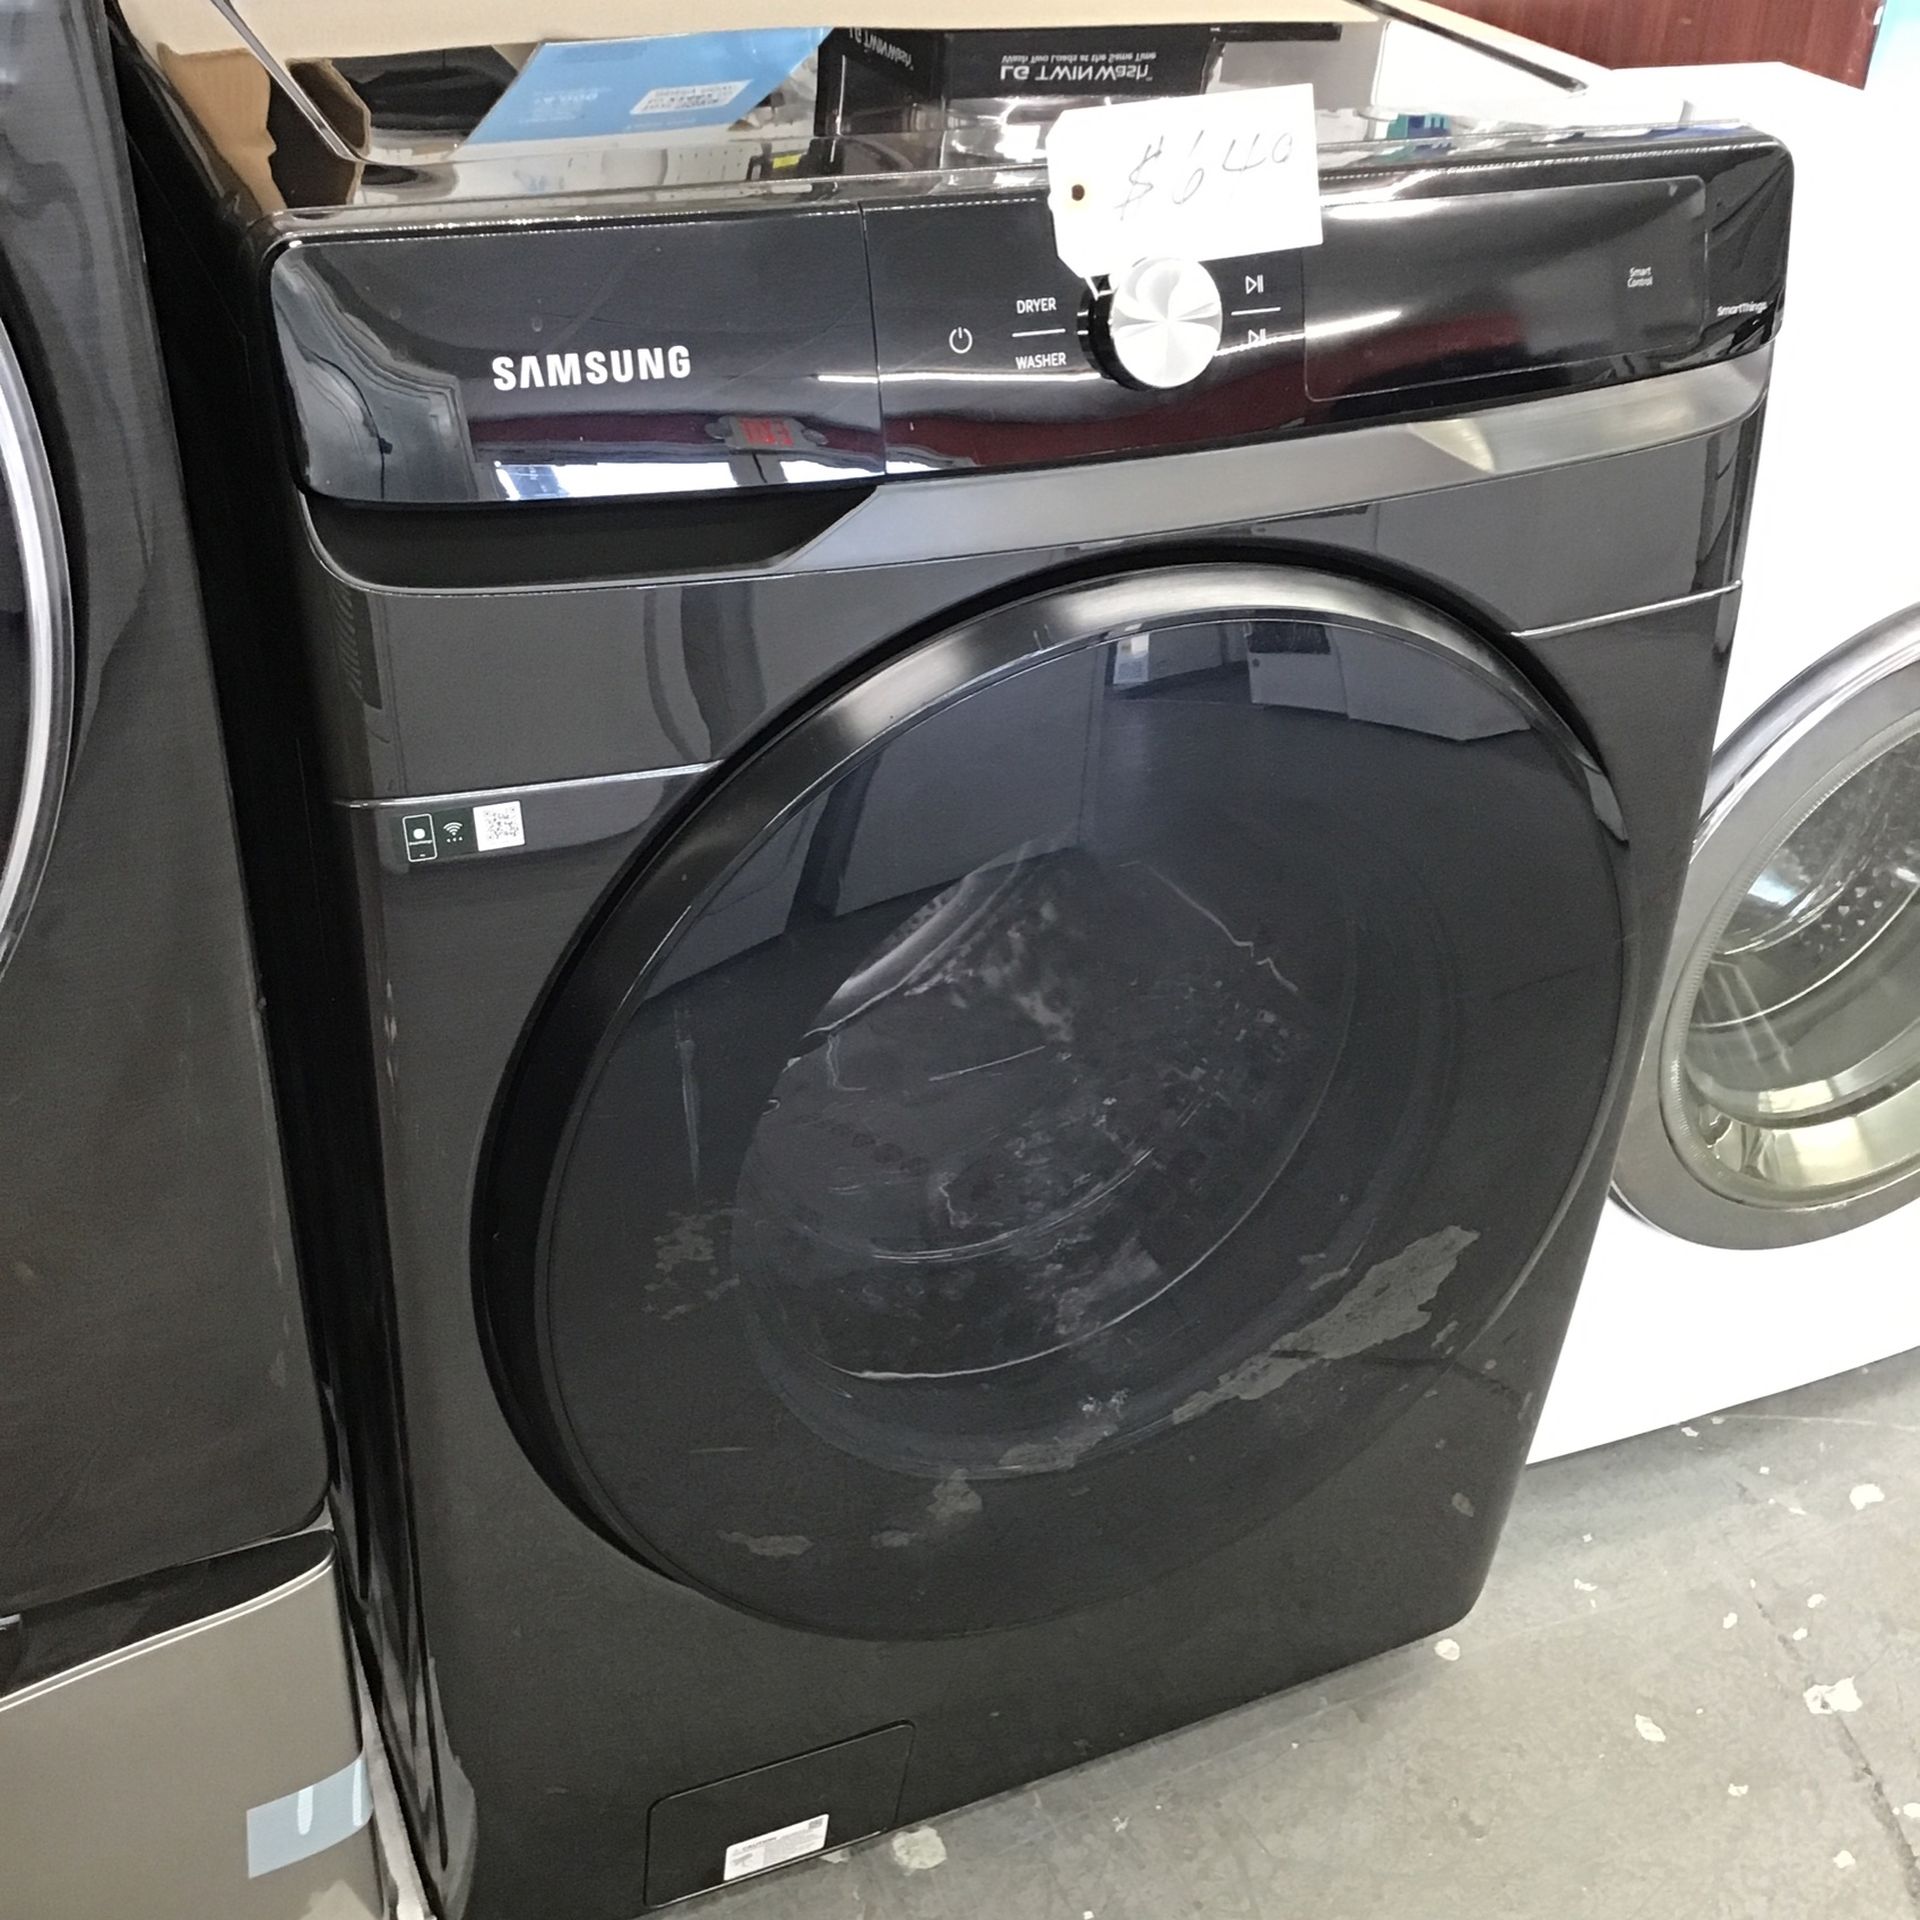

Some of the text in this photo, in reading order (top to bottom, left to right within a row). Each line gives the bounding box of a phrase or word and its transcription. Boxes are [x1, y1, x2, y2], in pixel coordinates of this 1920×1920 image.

[1629, 266, 1652, 278] Smart
[1627, 276, 1653, 288] Control
[1016, 296, 1057, 314] DRYER
[1716, 301, 1768, 317] SmartThings
[491, 345, 691, 391] SAMSUNG
[1015, 352, 1067, 370] WASHER
